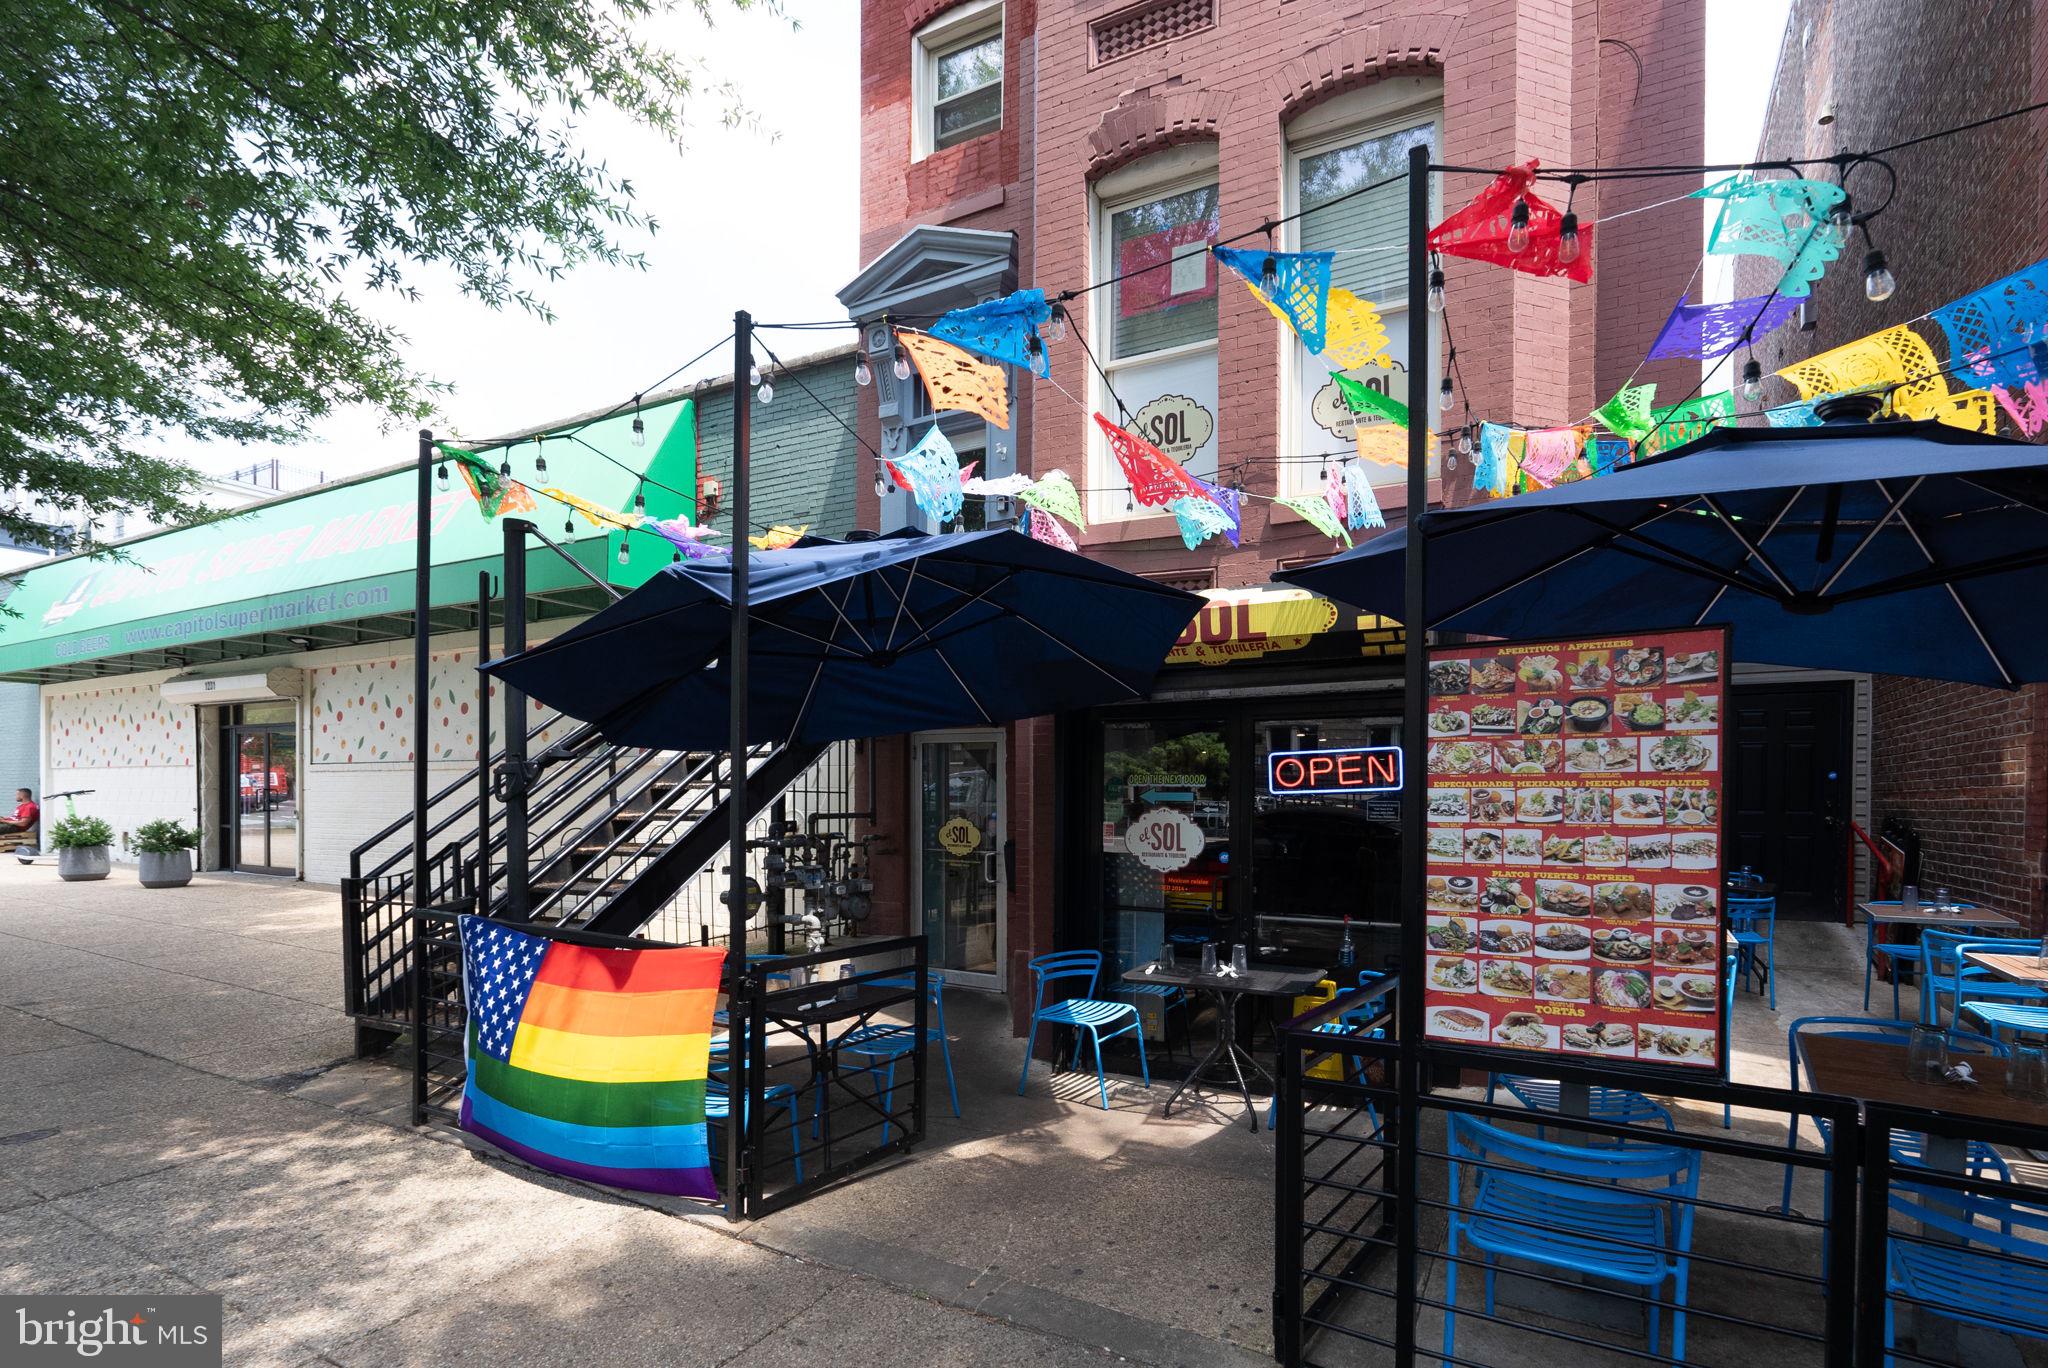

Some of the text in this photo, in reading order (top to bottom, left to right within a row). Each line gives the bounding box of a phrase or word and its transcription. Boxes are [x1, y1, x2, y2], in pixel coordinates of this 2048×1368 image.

[1151, 410, 1191, 447] SOL
[124, 584, 389, 646] www.capitolsupermarket.com
[1195, 645, 1206, 657] &
[1210, 641, 1281, 656] TEQUILERIA
[1498, 645, 1560, 656] APERITIVOS
[1568, 640, 1634, 650] APPETIZERS
[1276, 754, 1395, 787] OPEN
[1129, 775, 1206, 785] OPEN THE NEXT DOOR
[1638, 779, 1710, 787] SPECIALTIES
[952, 826, 971, 844] SOL
[1140, 827, 1150, 843] el
[1151, 822, 1187, 852] SOL
[1492, 870, 1530, 878] PLATOS
[1533, 872, 1580, 880] FUERTES
[1586, 873, 1635, 882] ENTREES
[1535, 1005, 1585, 1017] TORTAS
